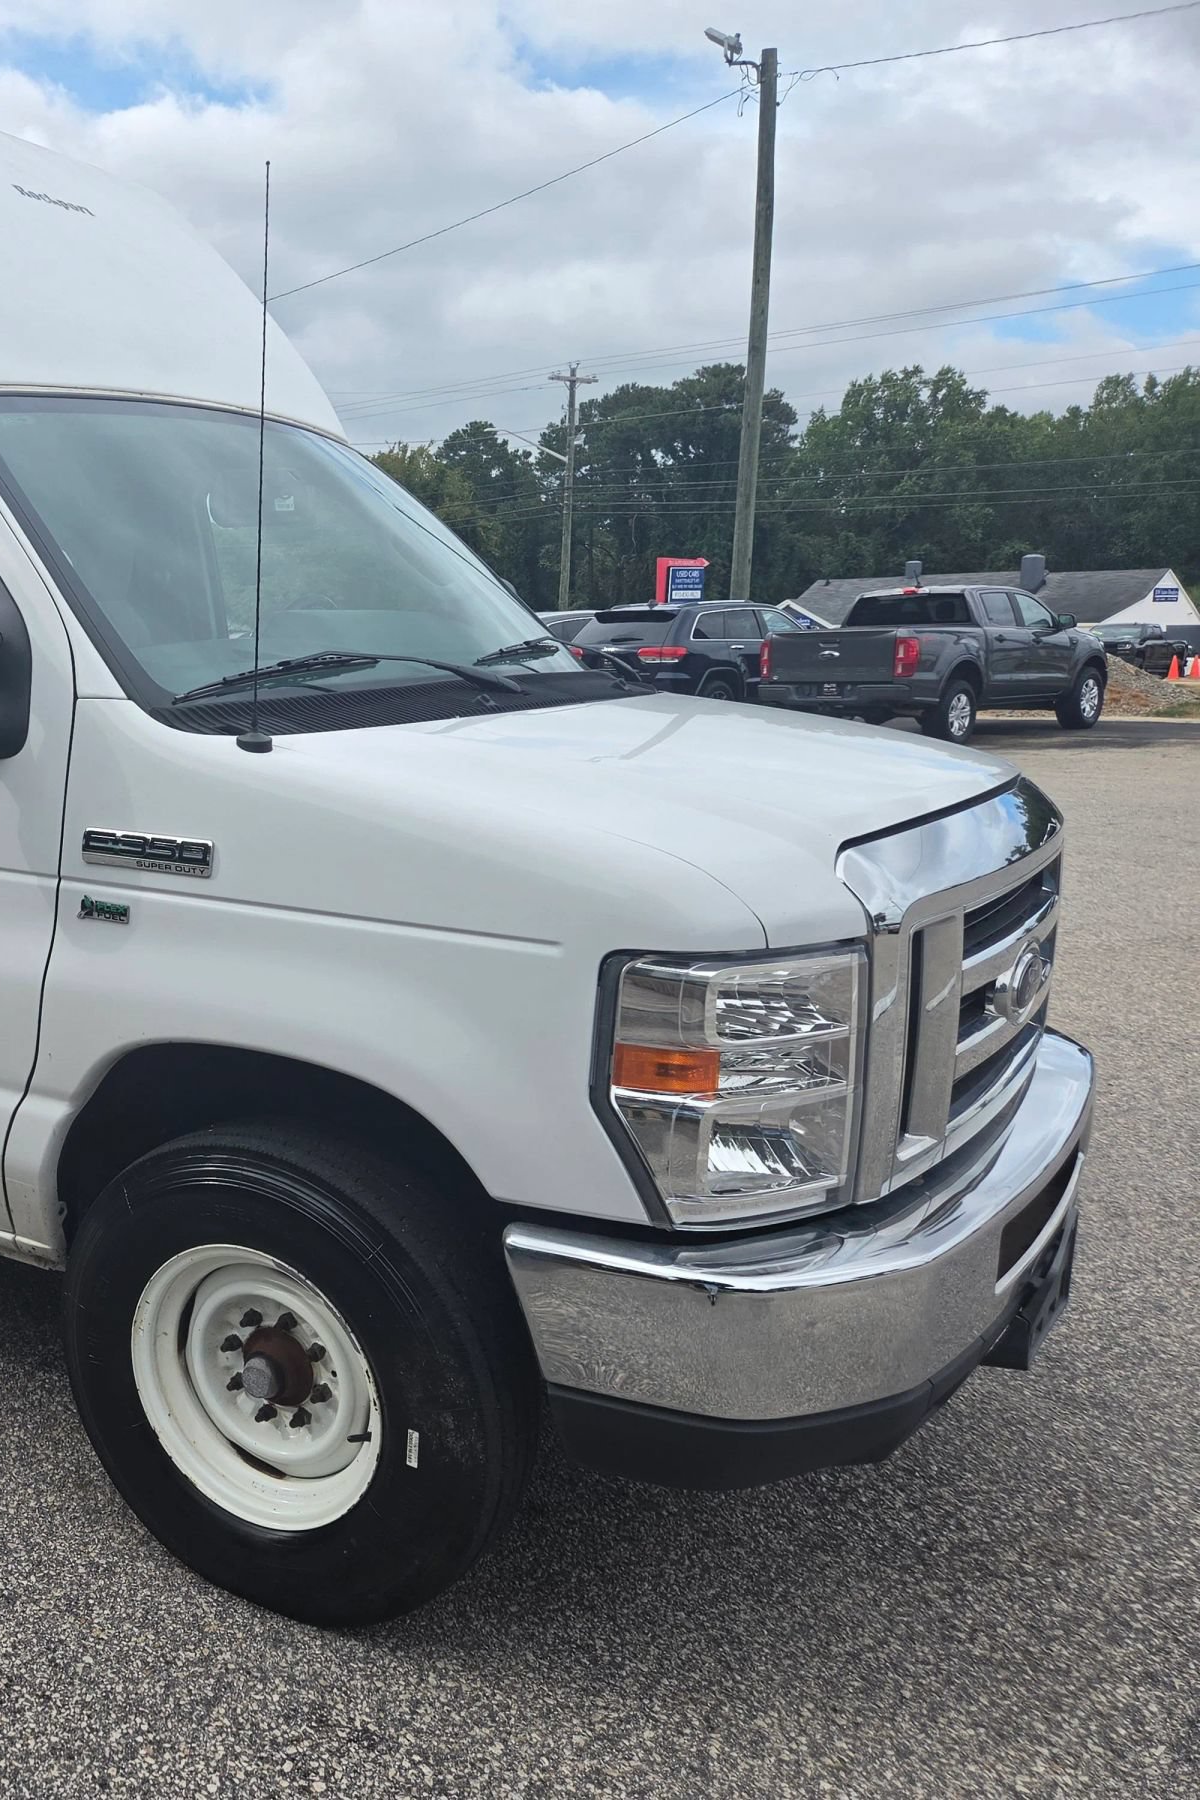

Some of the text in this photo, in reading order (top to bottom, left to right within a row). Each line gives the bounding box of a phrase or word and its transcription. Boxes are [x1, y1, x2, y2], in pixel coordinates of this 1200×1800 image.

[135, 860, 206, 875] SUPER DUTY
[96, 901, 125, 913] FLEX
[97, 912, 126, 922] FUEL
